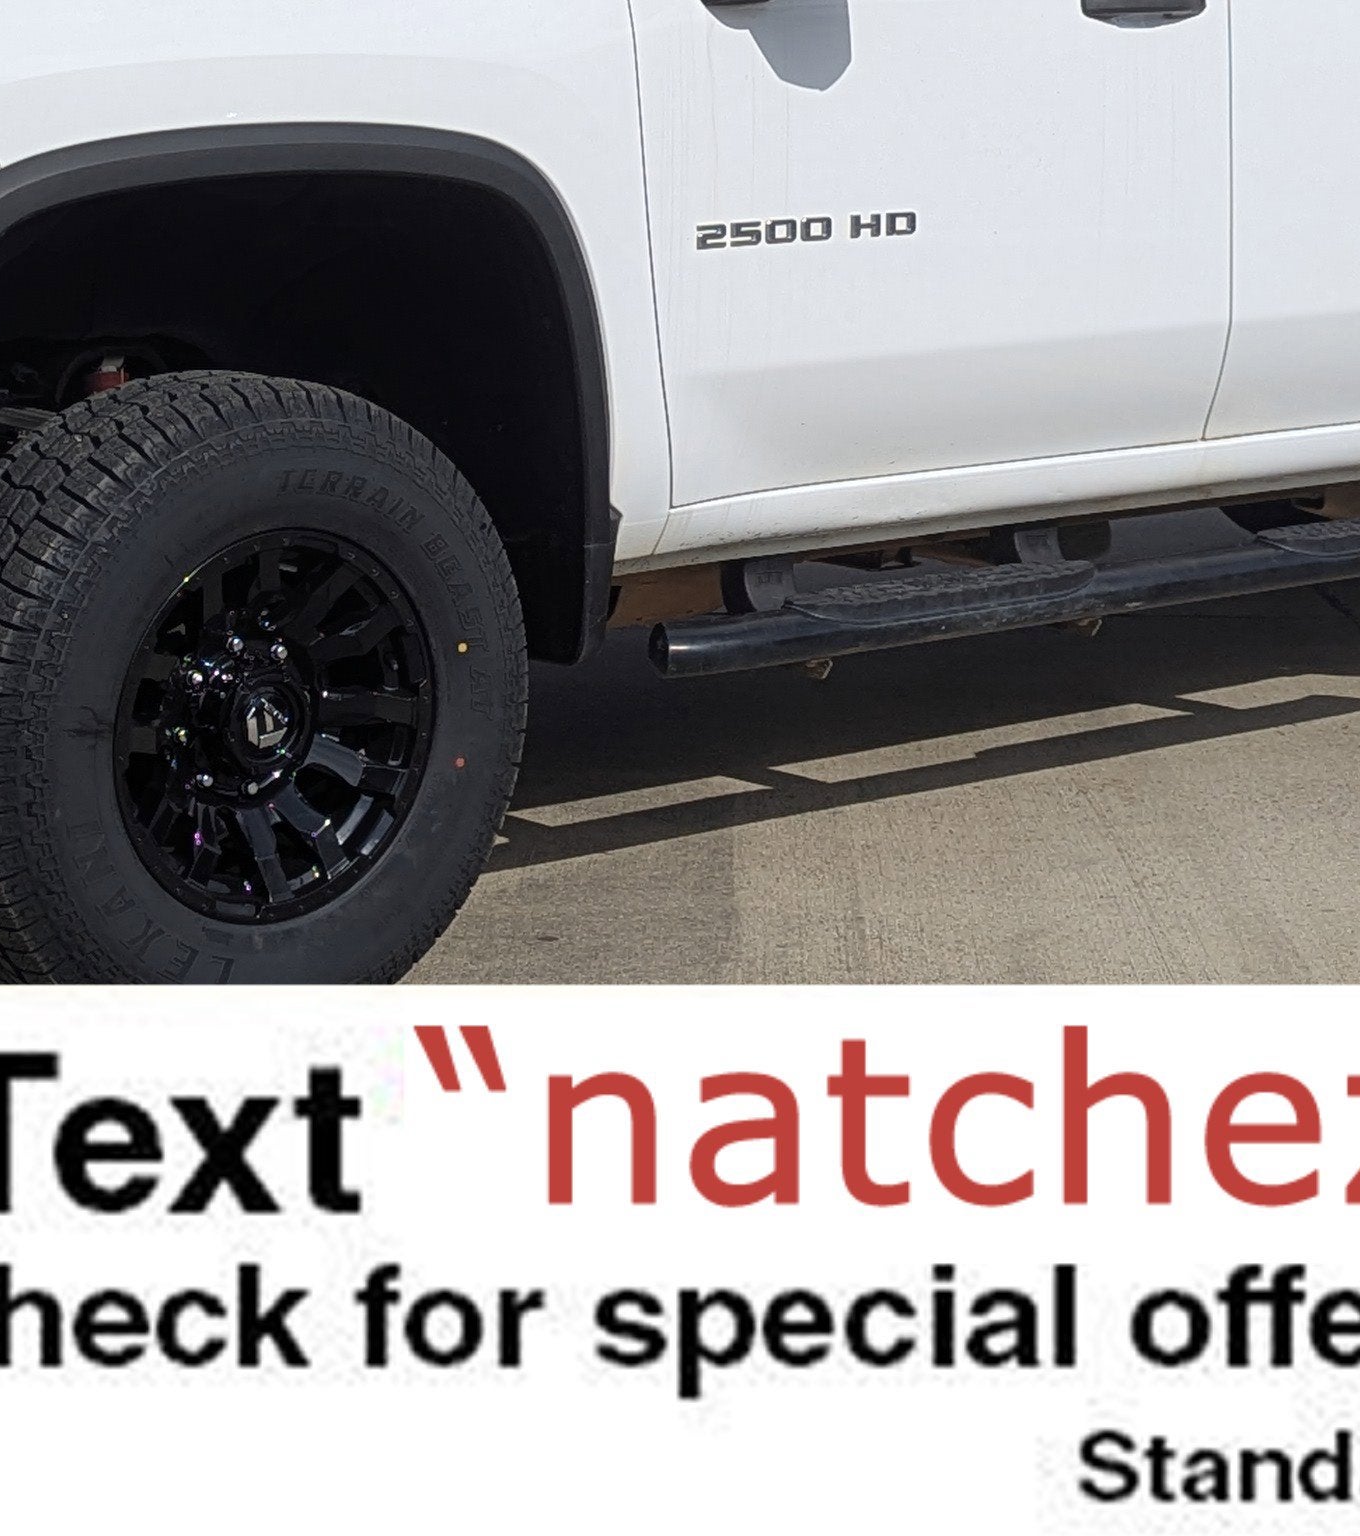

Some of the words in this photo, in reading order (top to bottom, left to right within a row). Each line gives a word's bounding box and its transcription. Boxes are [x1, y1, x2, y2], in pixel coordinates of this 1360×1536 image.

[696, 216, 833, 250] 2500
[849, 211, 917, 239] HD
[277, 468, 427, 534] TERRAIN
[419, 532, 491, 654] BEAST
